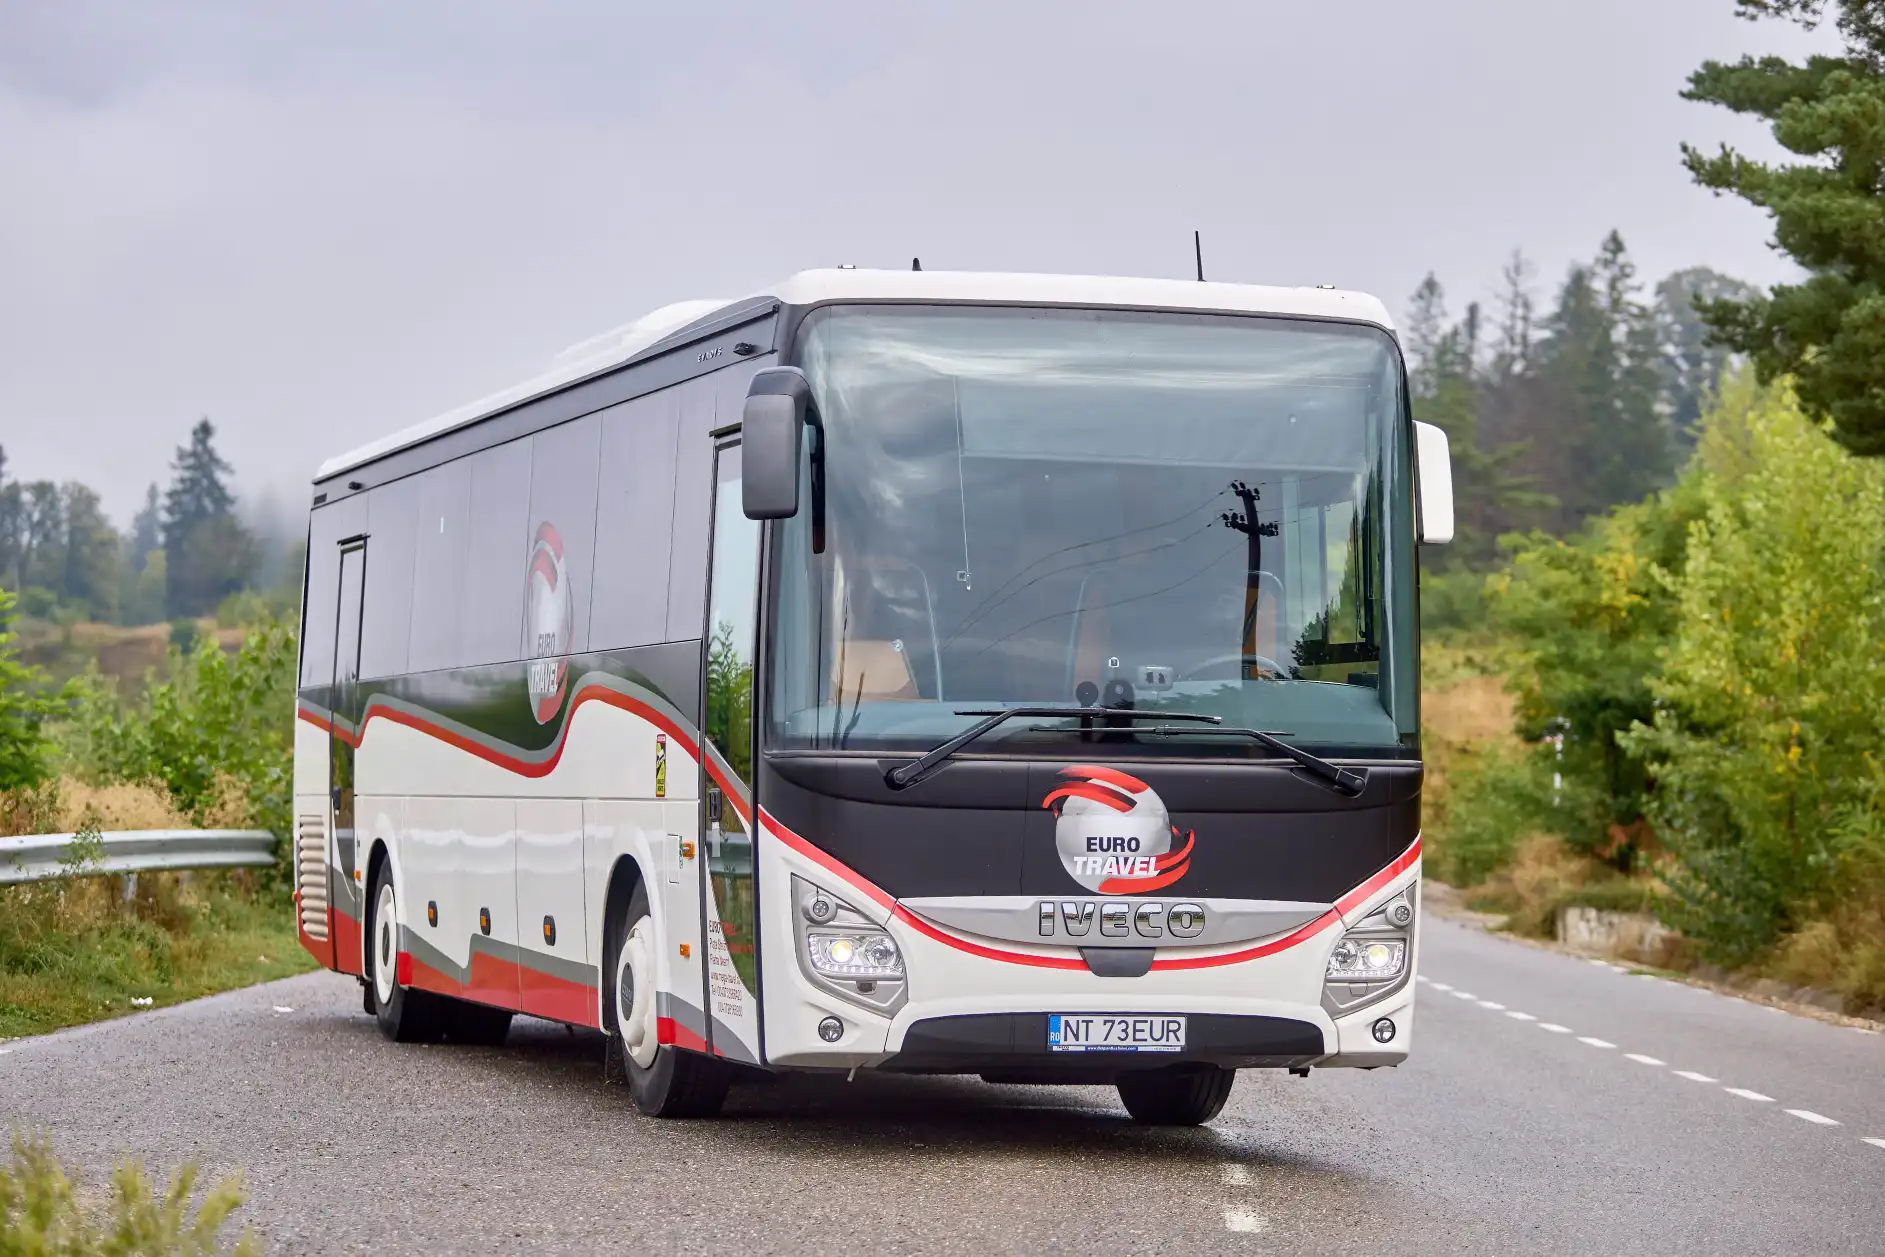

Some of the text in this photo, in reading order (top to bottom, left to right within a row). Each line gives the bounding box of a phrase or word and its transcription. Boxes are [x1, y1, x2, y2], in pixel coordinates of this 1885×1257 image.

[537, 632, 556, 658] EURO
[531, 662, 558, 693] TRAVEL
[1086, 836, 1140, 852] EURO
[1073, 856, 1160, 876] TRAVEL
[1039, 902, 1205, 938] IVECO
[1050, 1020, 1182, 1042] RO NT 73EUR
